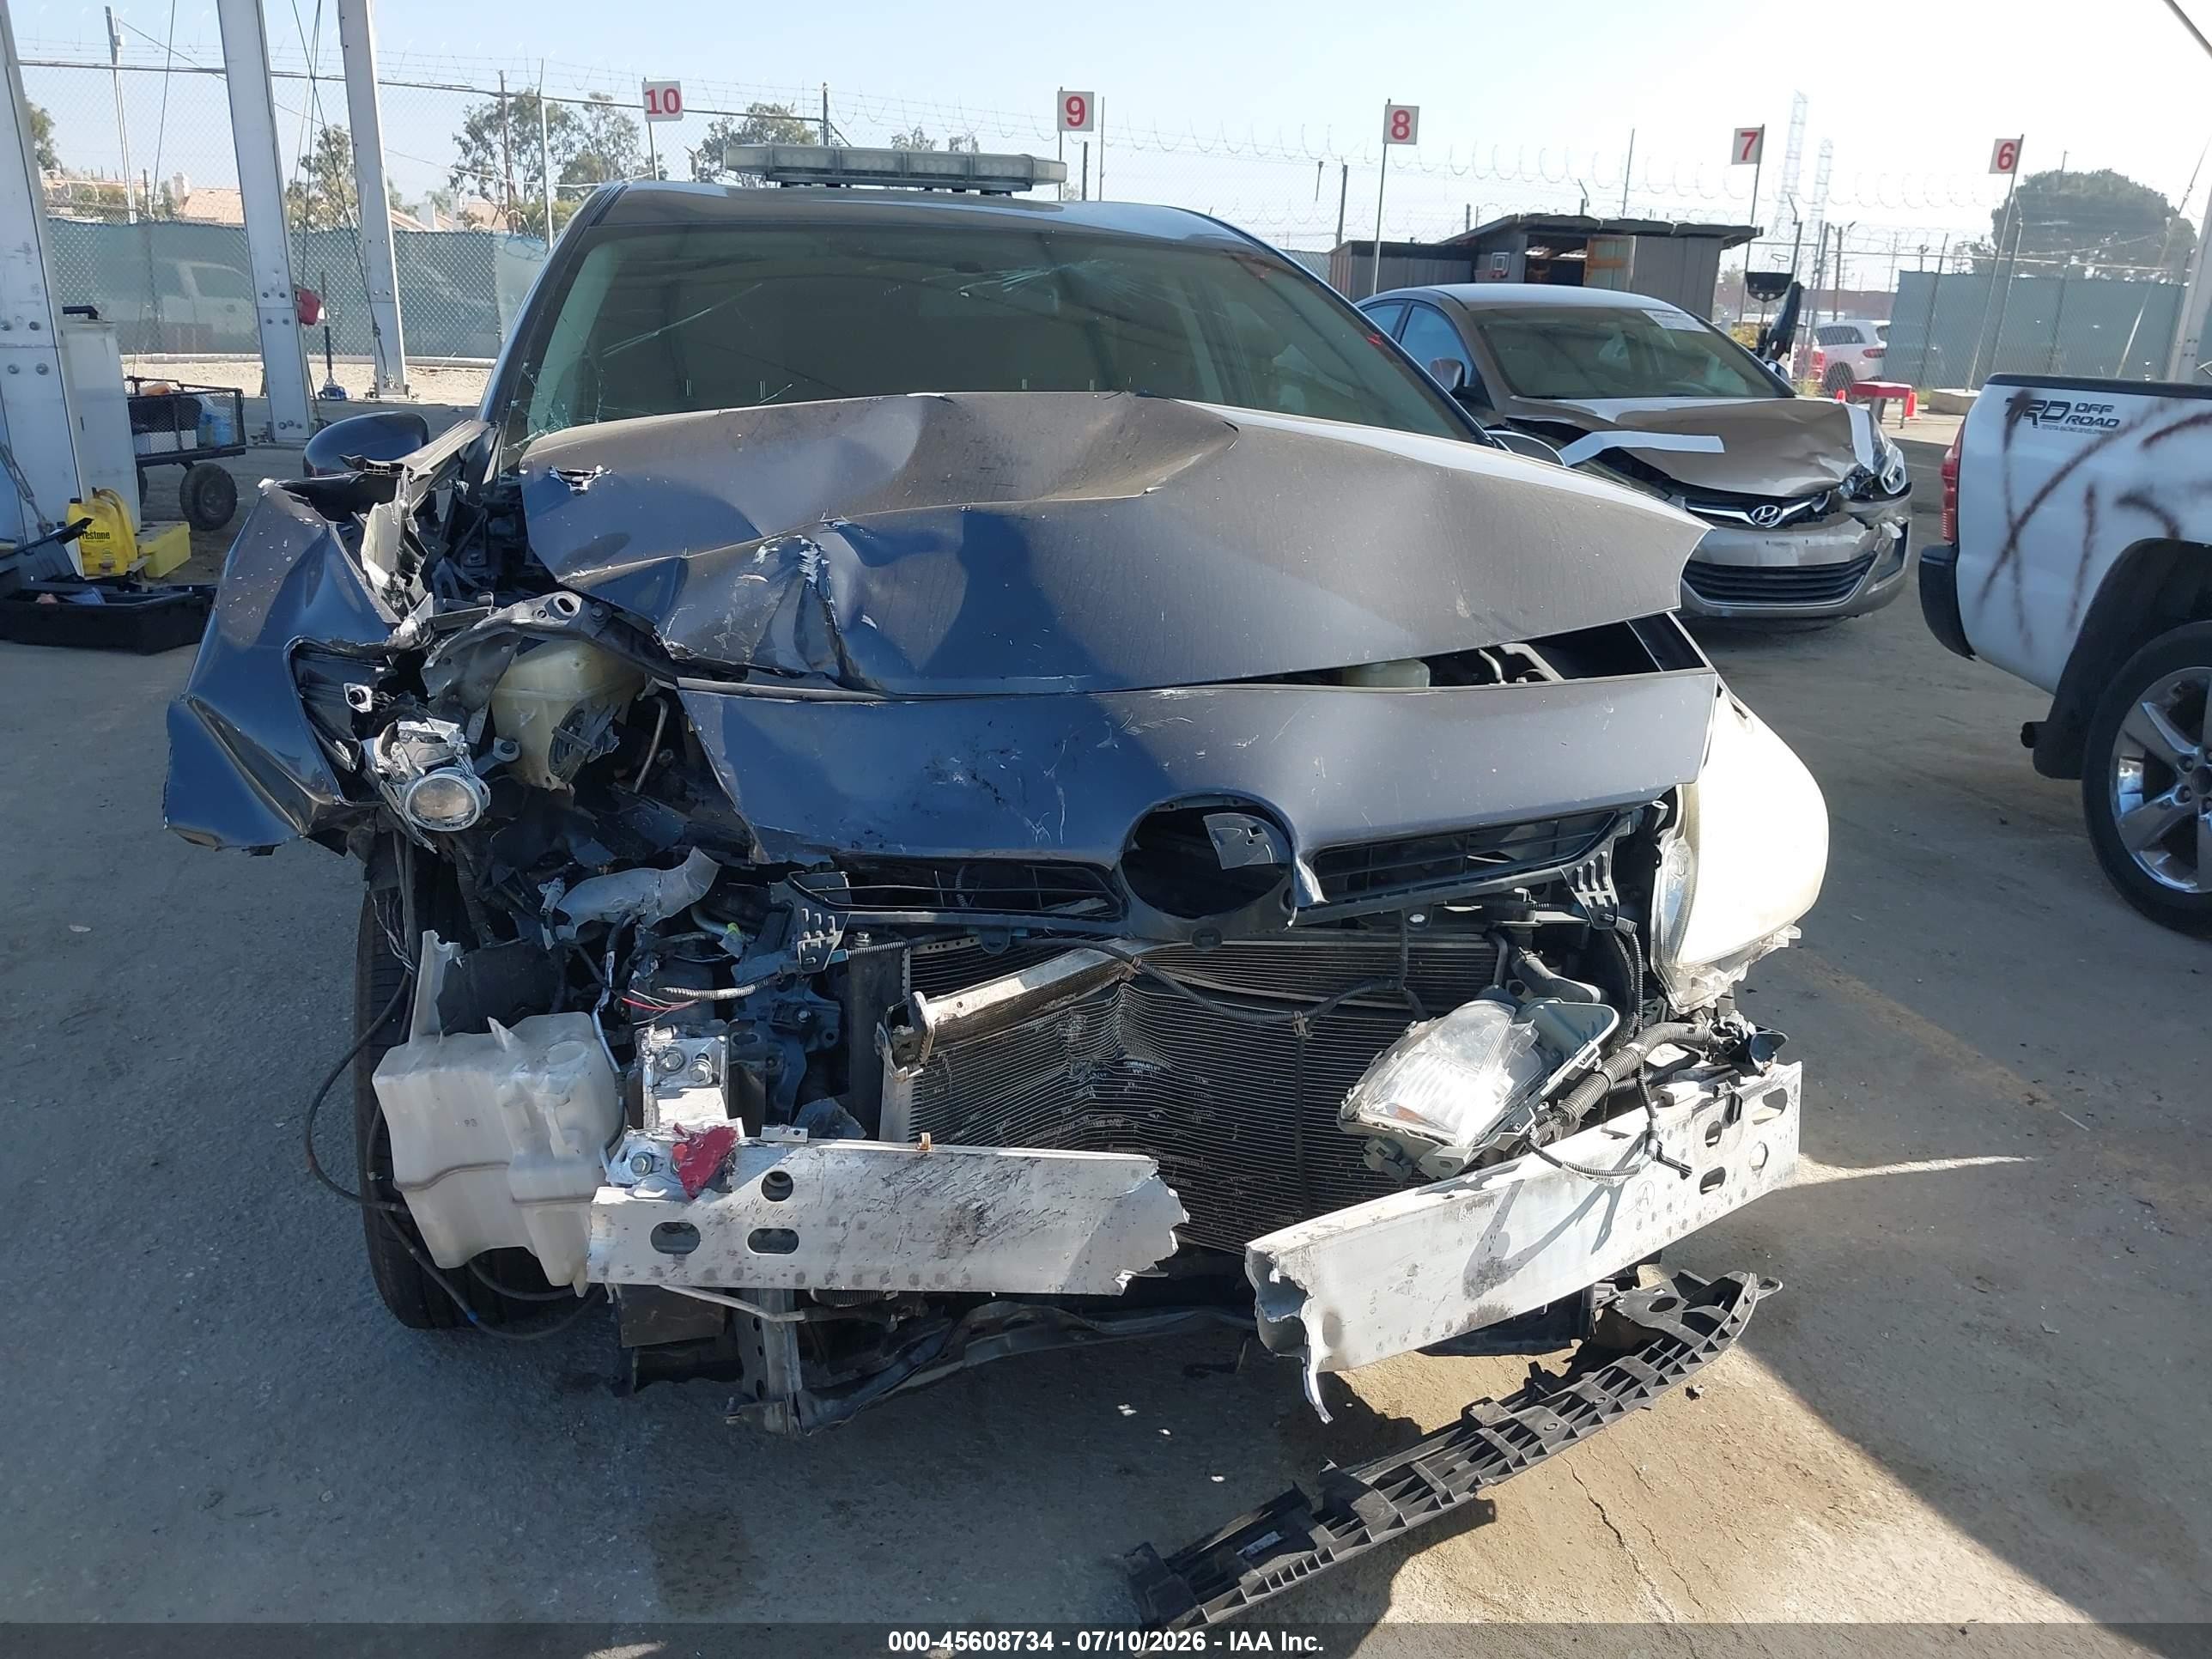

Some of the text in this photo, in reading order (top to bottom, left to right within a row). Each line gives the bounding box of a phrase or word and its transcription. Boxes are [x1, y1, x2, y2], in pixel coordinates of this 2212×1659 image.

[645, 88, 681, 114] 10
[1066, 96, 1085, 126] 9
[1391, 110, 1411, 140] 8
[1741, 131, 1759, 161] 7
[1997, 143, 2015, 170] 6
[2005, 398, 2071, 428] TRD
[2065, 415, 2120, 428] ROAD
[2075, 403, 2115, 414] OFF
[82, 531, 111, 540] restone
